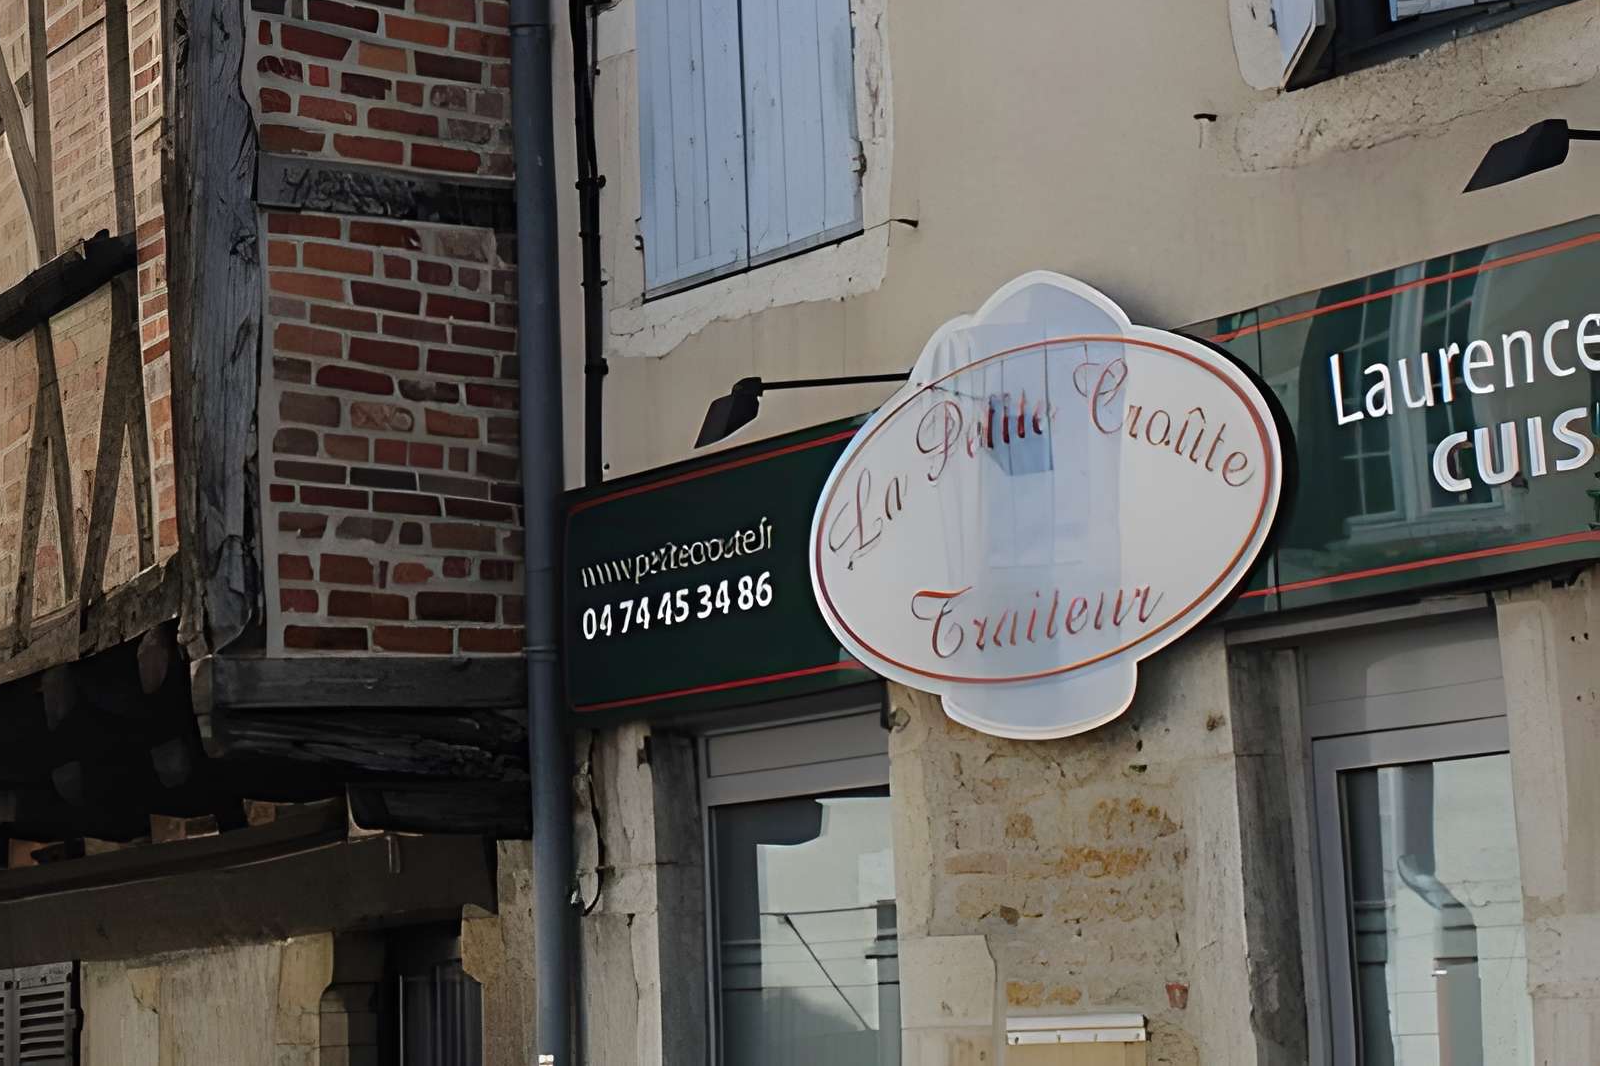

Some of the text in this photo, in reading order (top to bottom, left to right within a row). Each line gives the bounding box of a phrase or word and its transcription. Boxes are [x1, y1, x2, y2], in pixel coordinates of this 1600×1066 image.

[1329, 313, 1600, 425] Laurence
[1432, 406, 1595, 492] CUIS
[582, 570, 774, 640] 04 74 45 34 86
